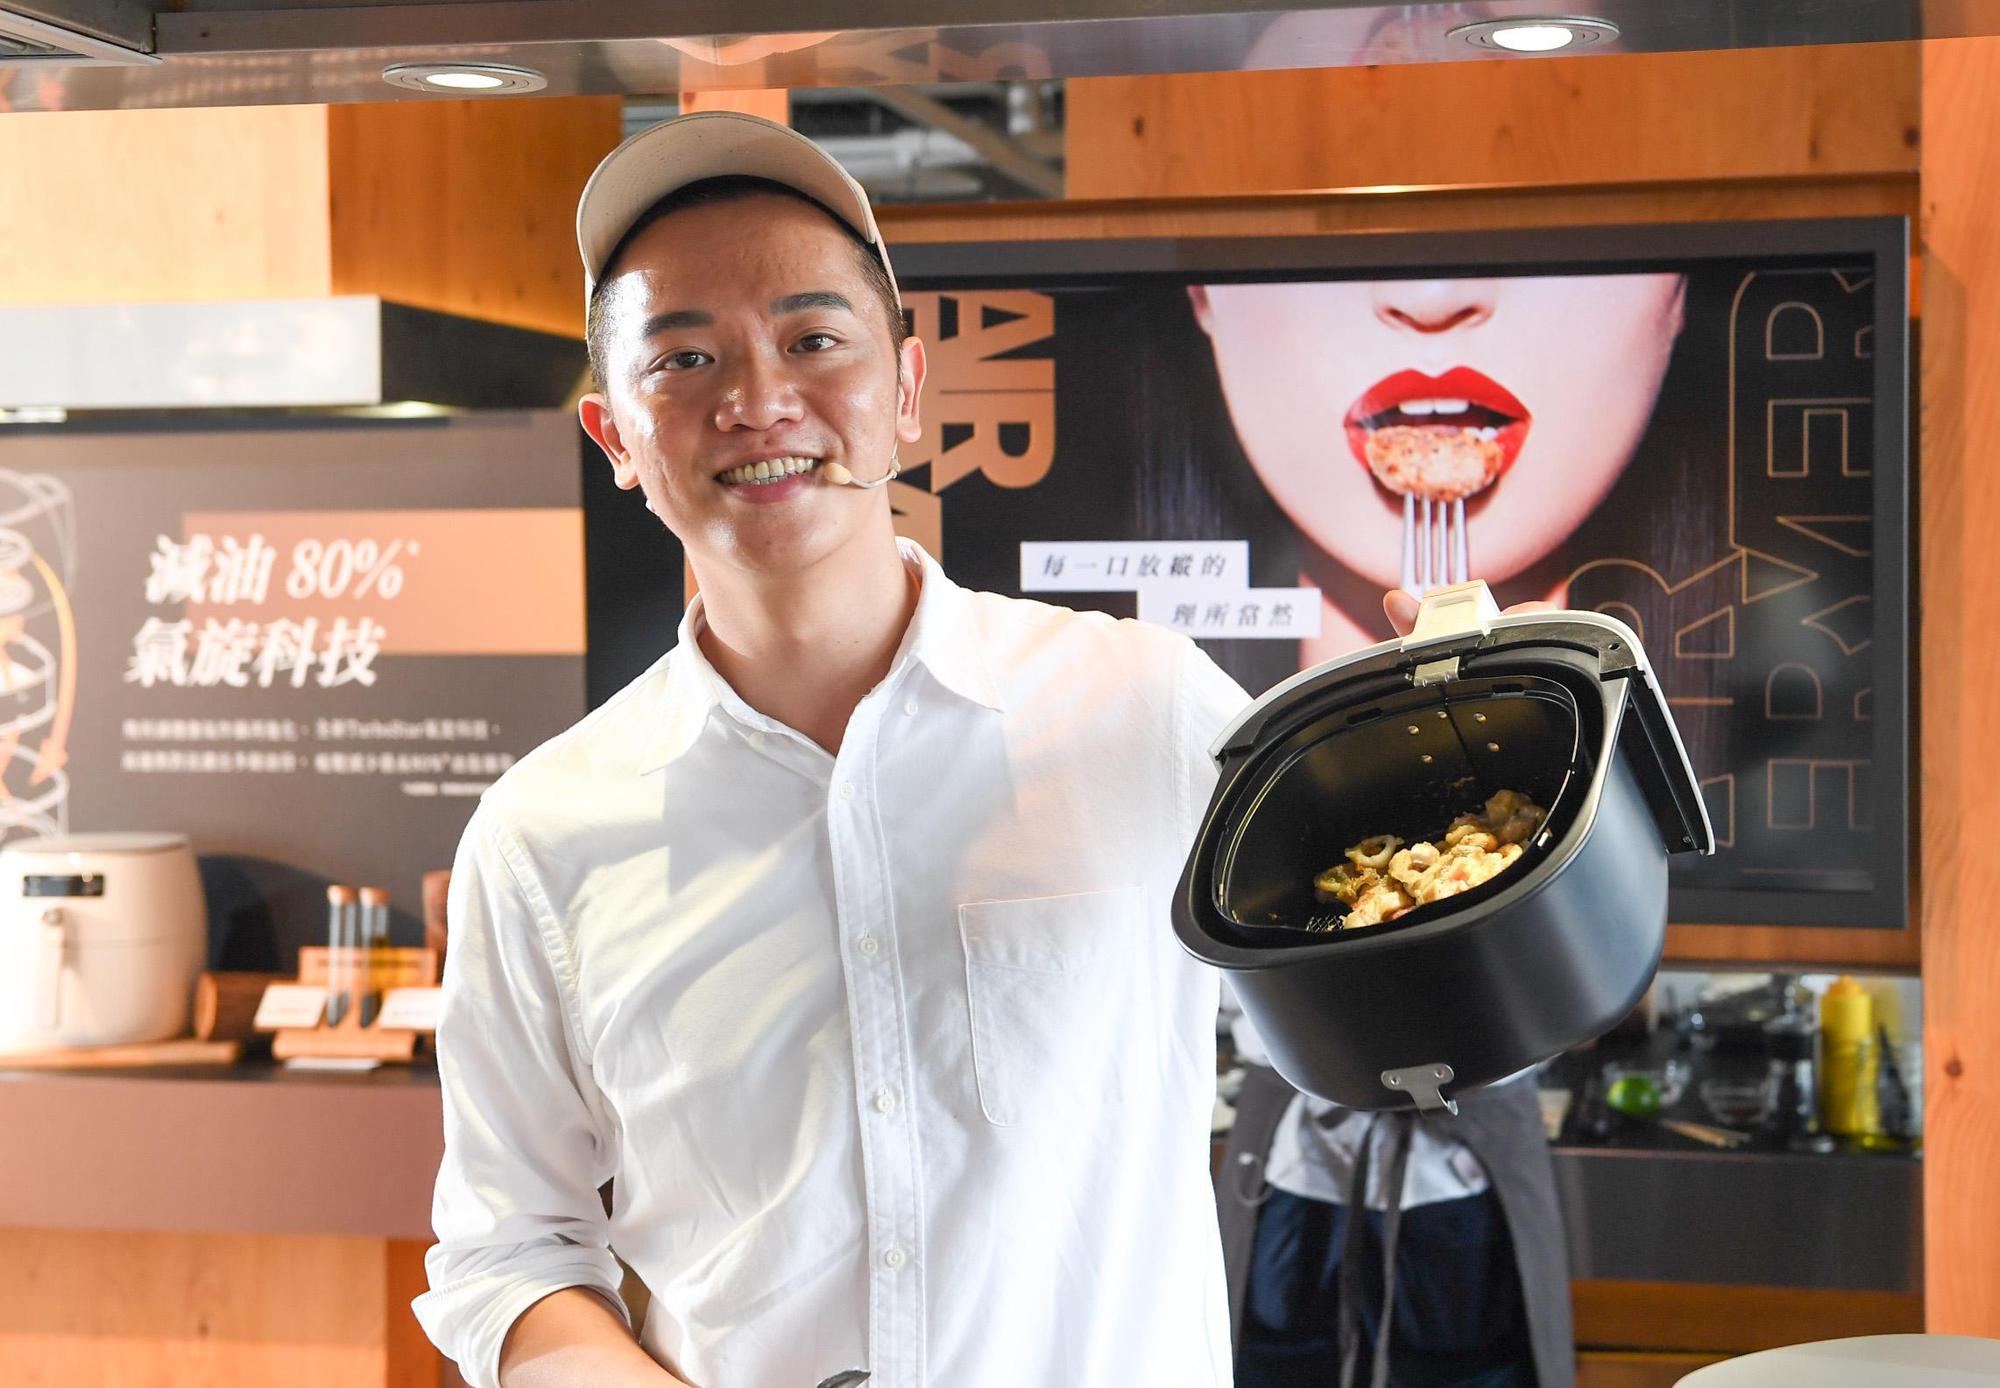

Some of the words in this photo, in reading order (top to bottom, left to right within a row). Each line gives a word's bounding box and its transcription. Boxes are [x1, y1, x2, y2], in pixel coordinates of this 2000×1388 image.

[930, 289, 1056, 494] AIR
[145, 534, 277, 604] 減油
[1042, 553, 1227, 579] 每一口放縱的
[1172, 604, 1294, 628] 理所當然
[125, 617, 386, 688] 氣旋科技
